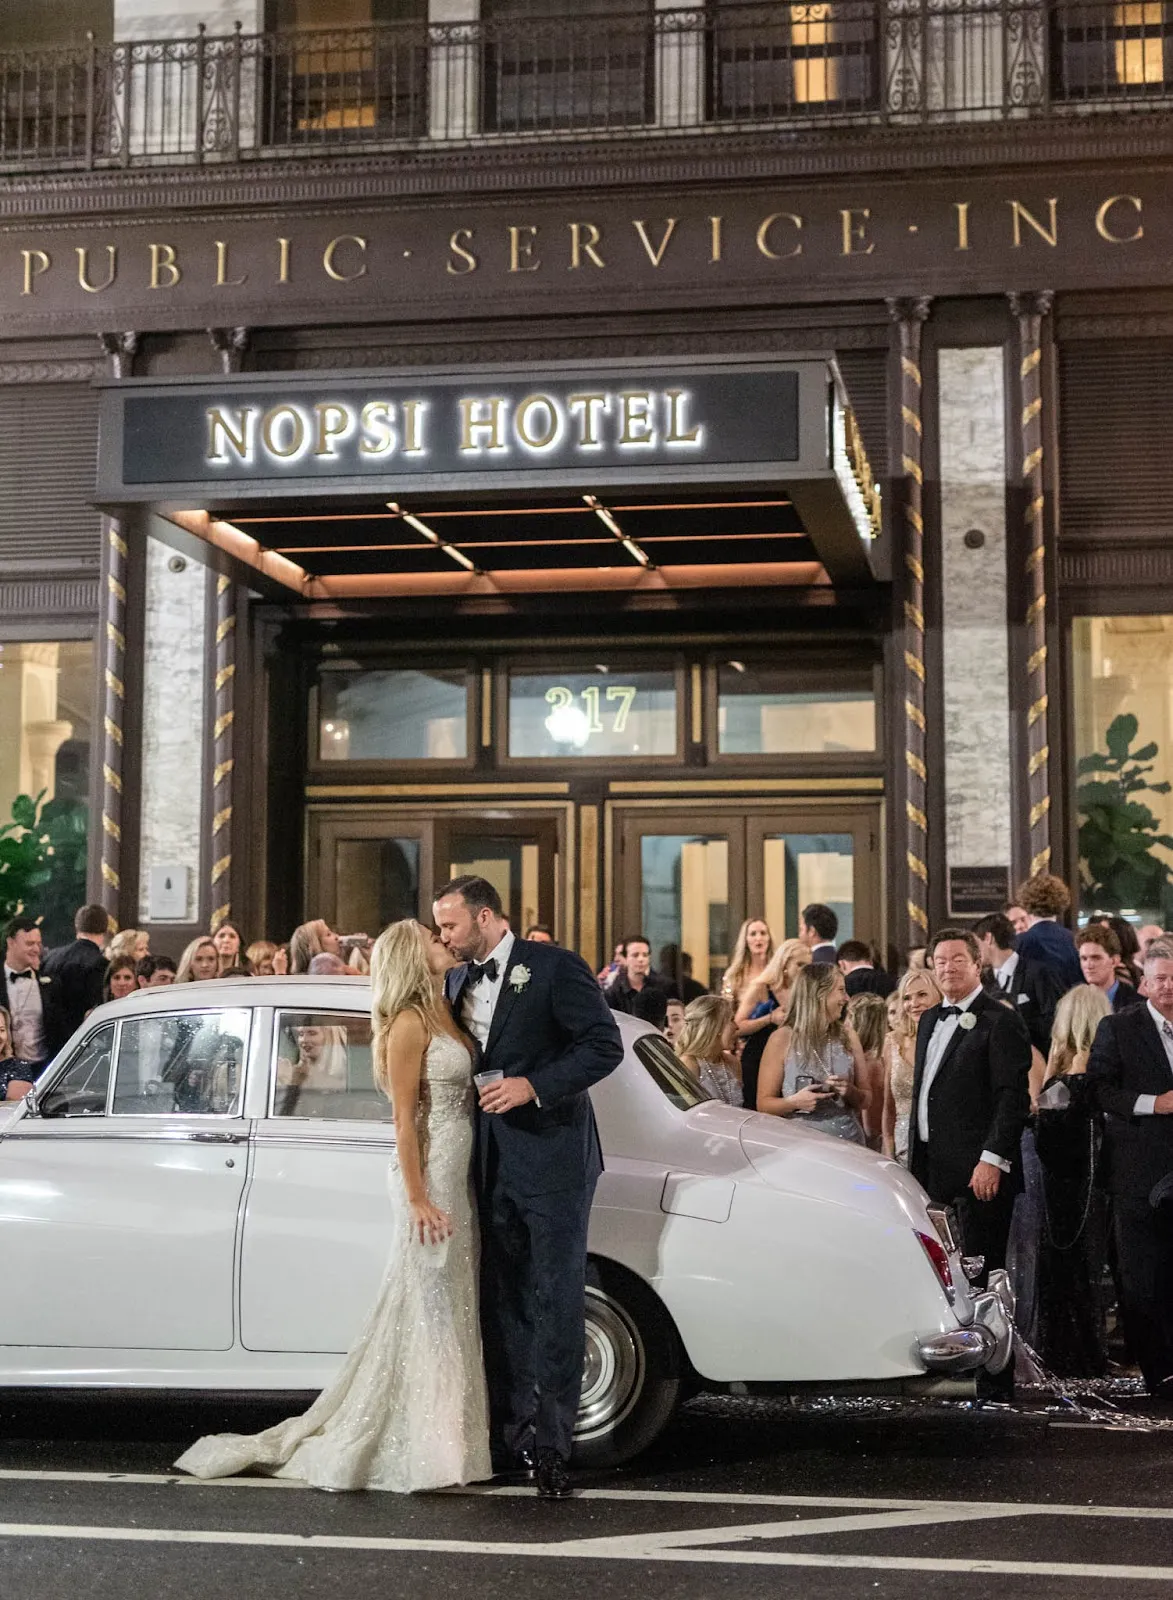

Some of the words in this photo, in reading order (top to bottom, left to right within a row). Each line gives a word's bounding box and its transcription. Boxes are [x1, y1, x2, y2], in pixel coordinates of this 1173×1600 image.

[20, 233, 368, 296] PUBLIC
[445, 207, 875, 275] SERVICE
[953, 194, 1145, 251] INC
[206, 400, 428, 464] NOPSI
[459, 389, 704, 453] HOTEL
